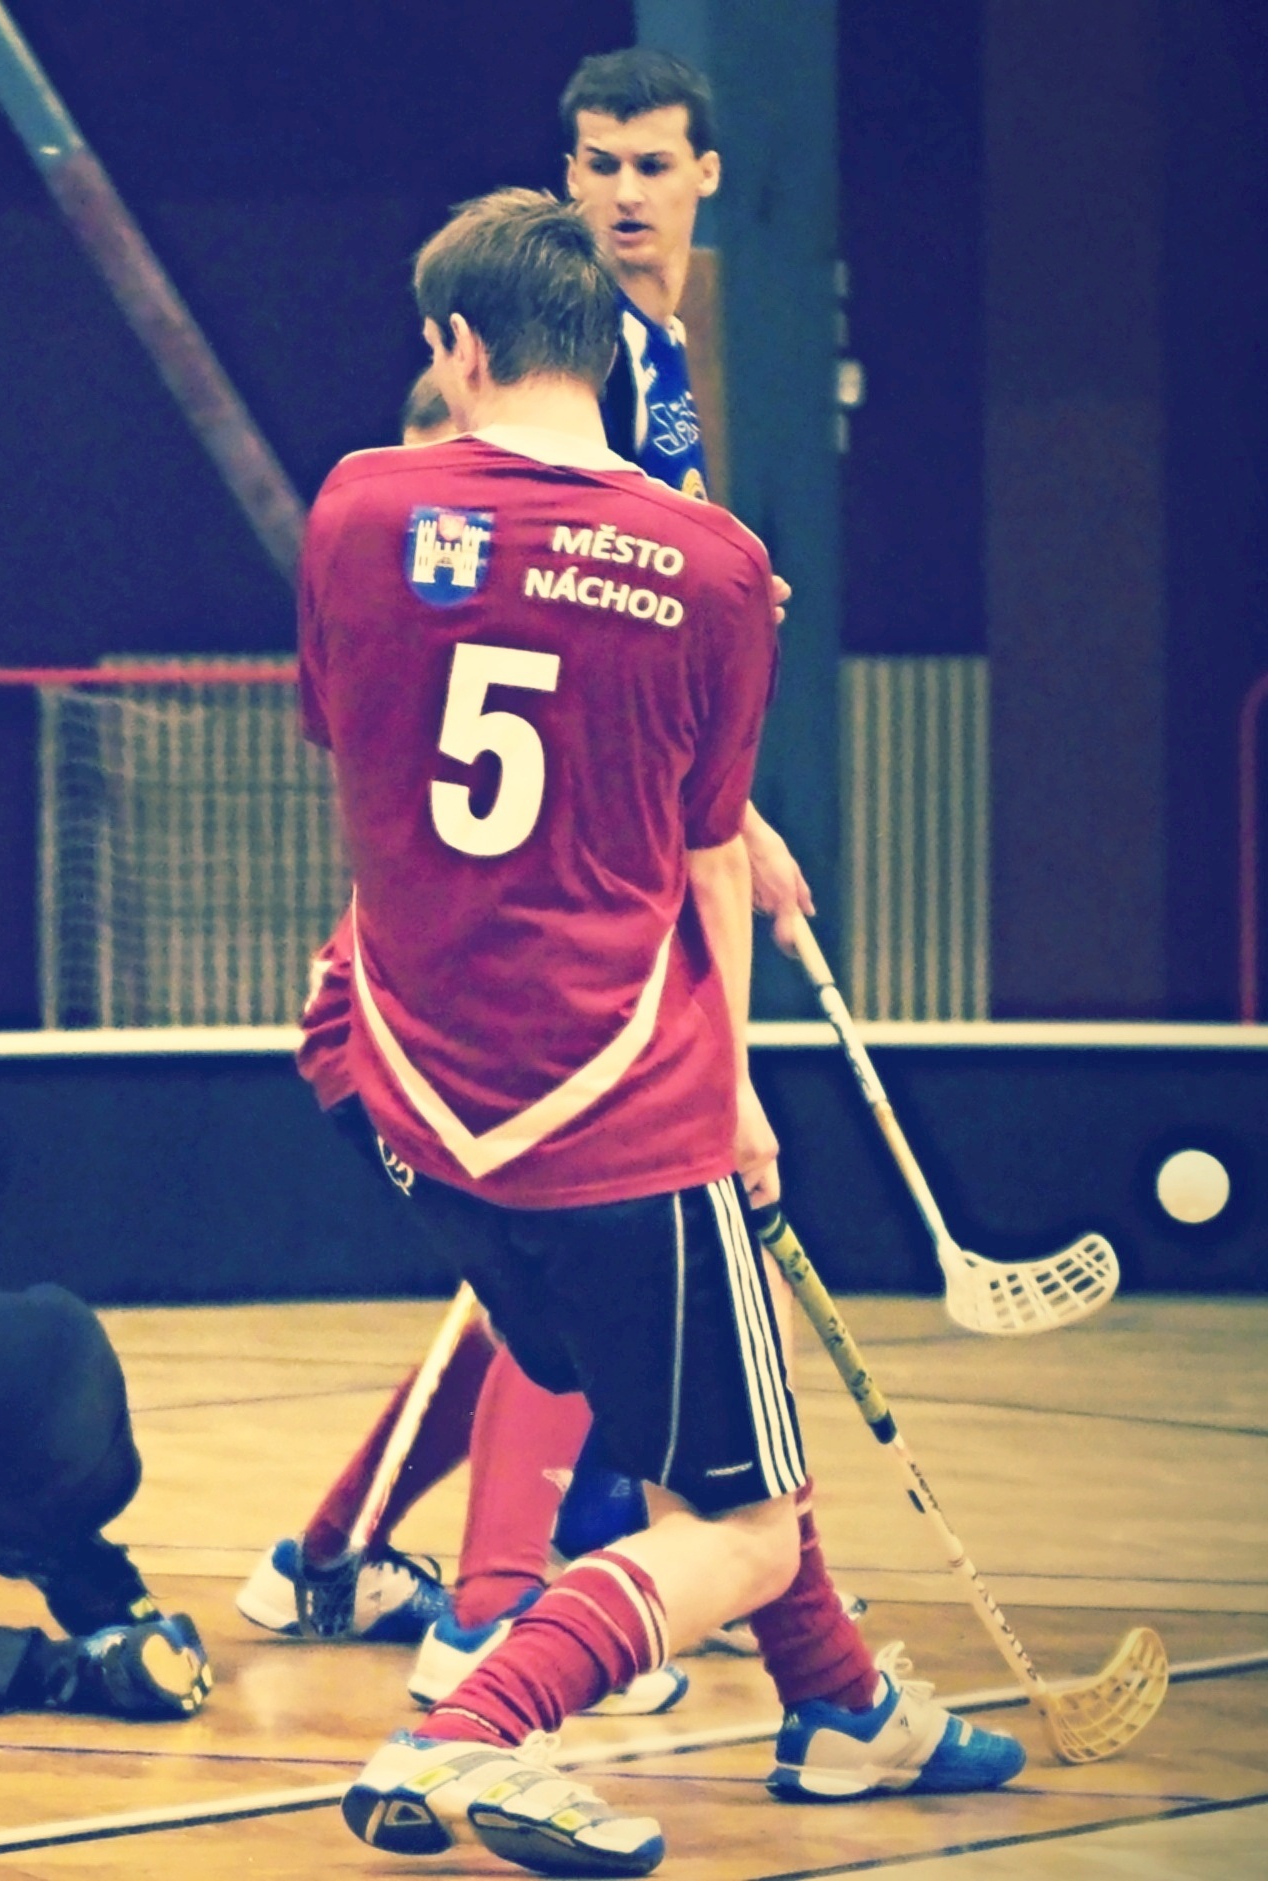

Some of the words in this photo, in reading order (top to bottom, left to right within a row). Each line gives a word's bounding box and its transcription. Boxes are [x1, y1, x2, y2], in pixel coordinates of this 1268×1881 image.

[551, 524, 686, 577] MĚSTO
[524, 566, 686, 628] NÁCHOD
[429, 642, 561, 858] 5
